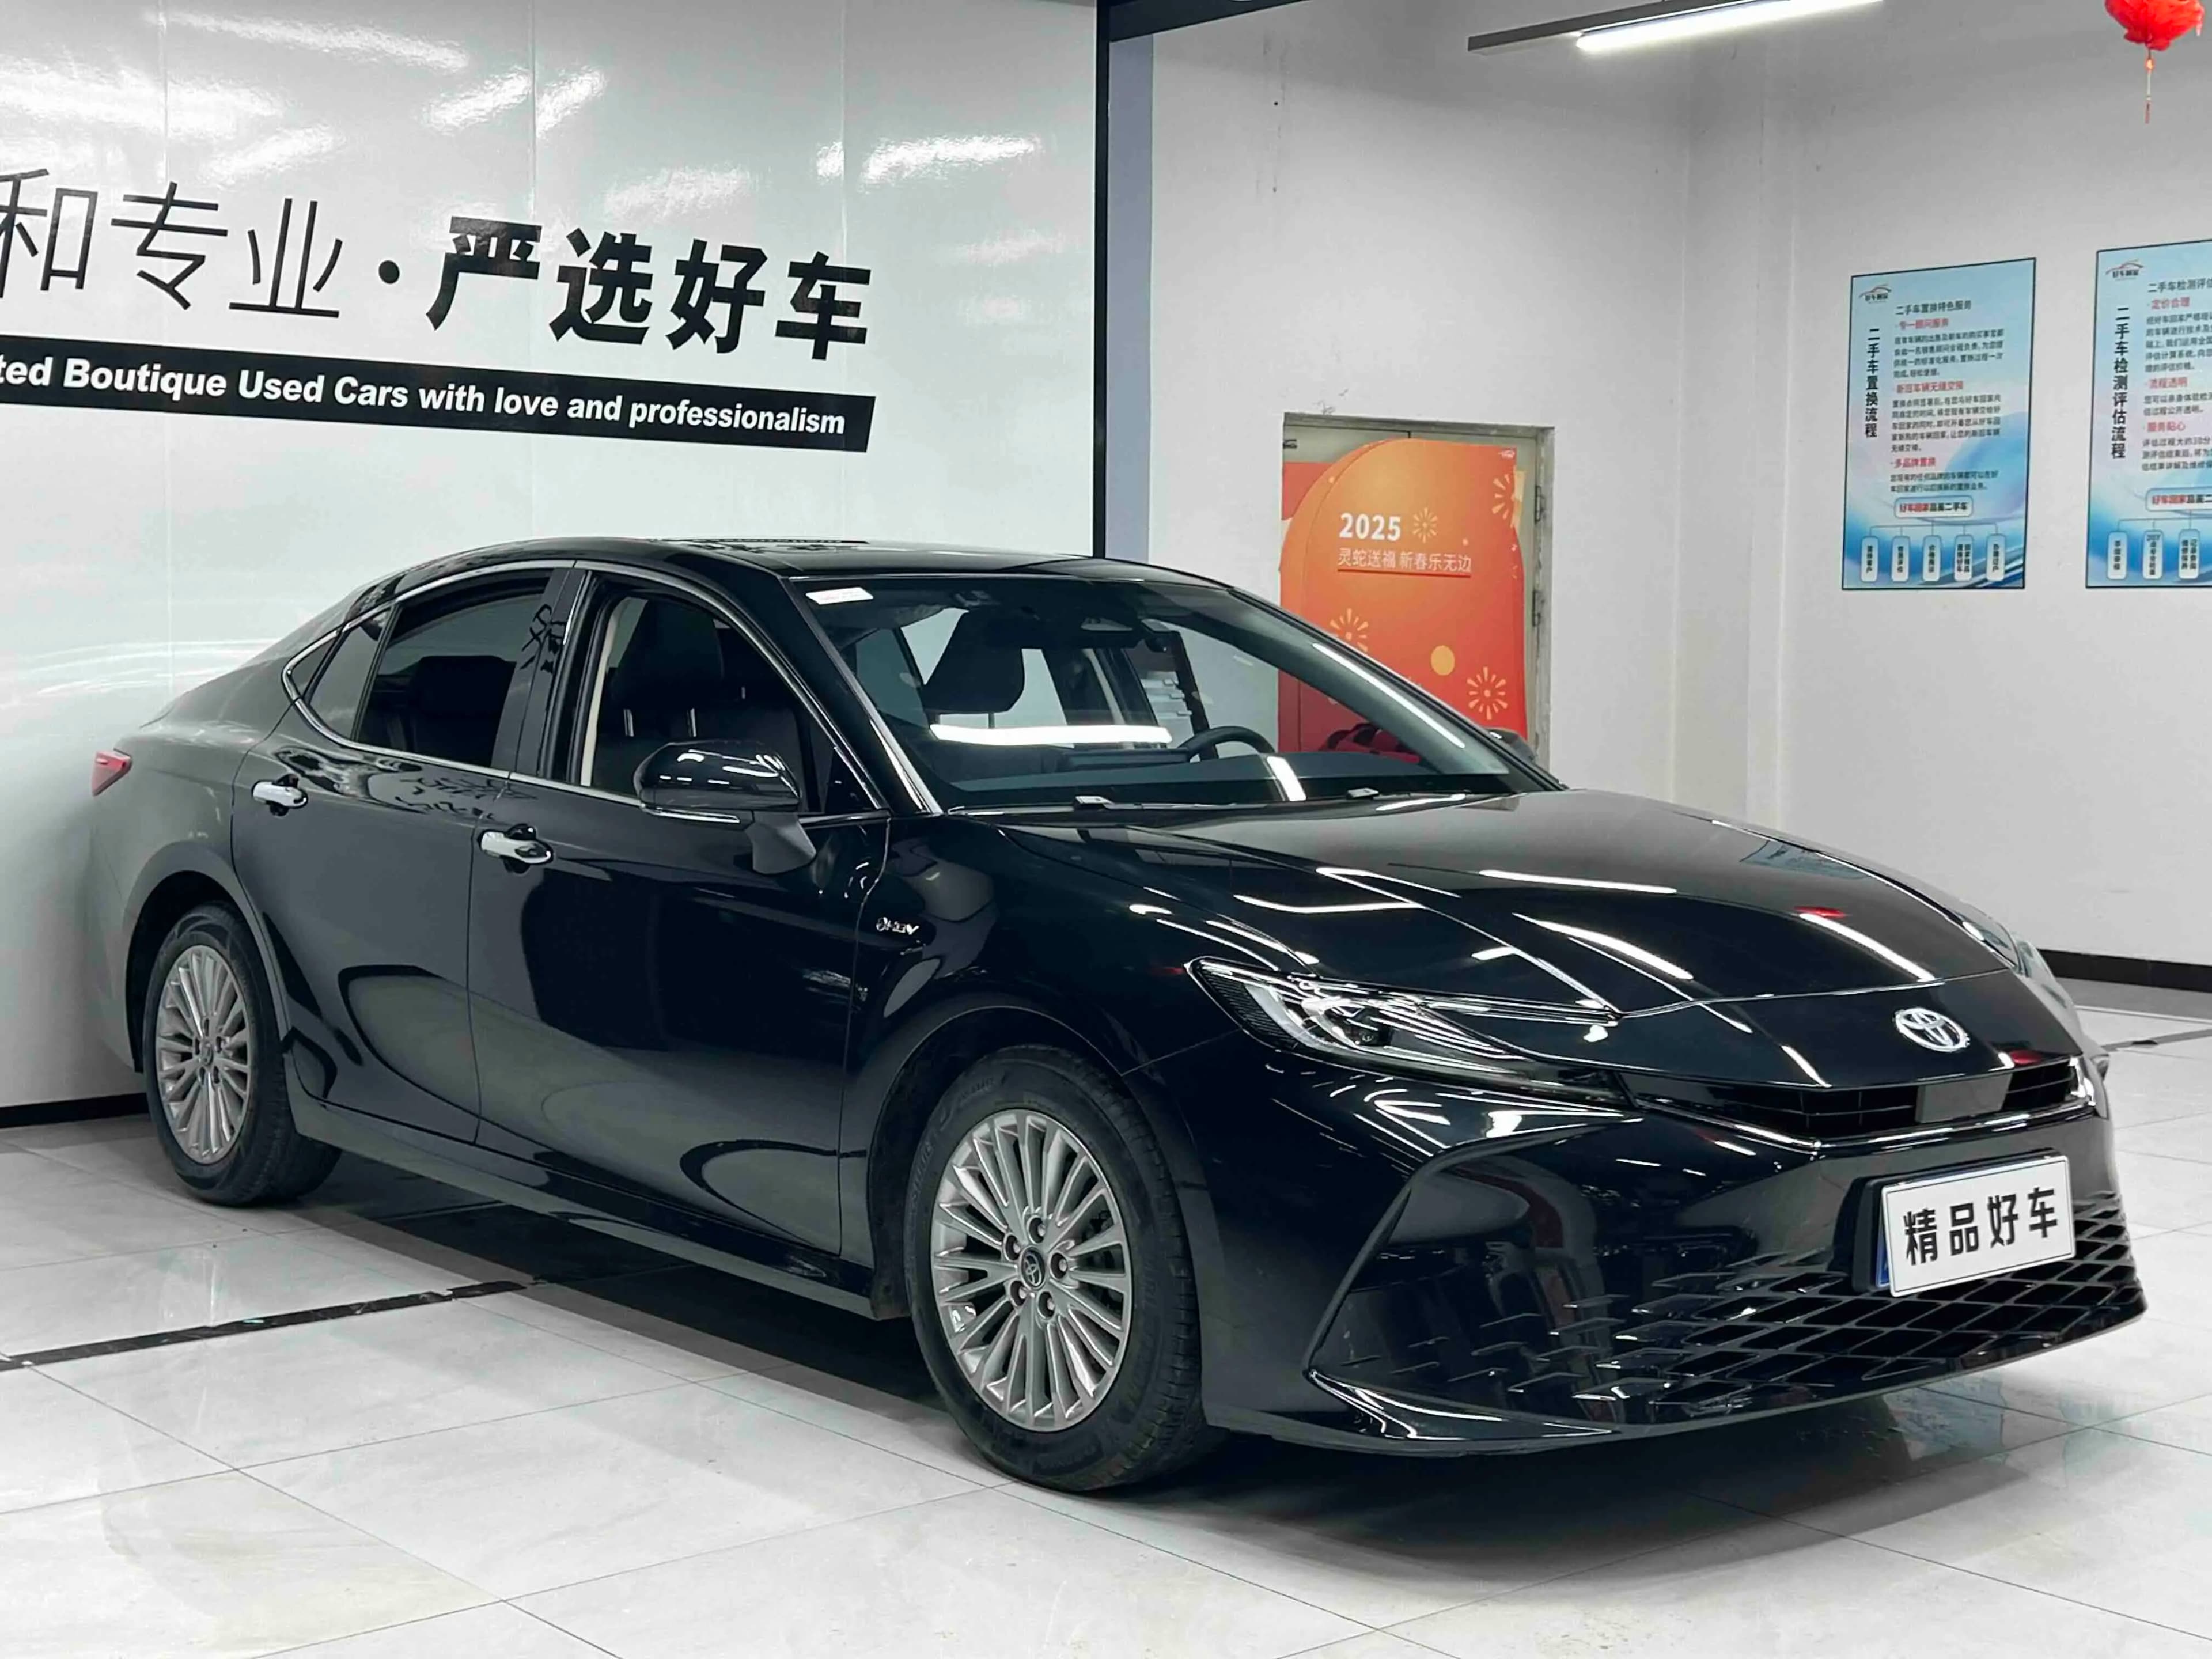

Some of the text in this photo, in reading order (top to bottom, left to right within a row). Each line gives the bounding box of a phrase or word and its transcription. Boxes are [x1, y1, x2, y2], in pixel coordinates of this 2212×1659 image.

[63, 358, 227, 401] Boutique
[238, 370, 325, 402] Used
[334, 376, 408, 407] Cars
[419, 385, 484, 411] with
[494, 387, 558, 416] love
[567, 395, 623, 421] and
[628, 399, 845, 434] professionalism
[1865, 328, 1880, 438] 二手车置换流程
[2112, 307, 2130, 459] 二手车检测评估流程
[1337, 547, 1472, 573] 灵蛇送福 新春乐无边
[1339, 512, 1402, 541] 2025
[1903, 1187, 2058, 1266] 精品好车
